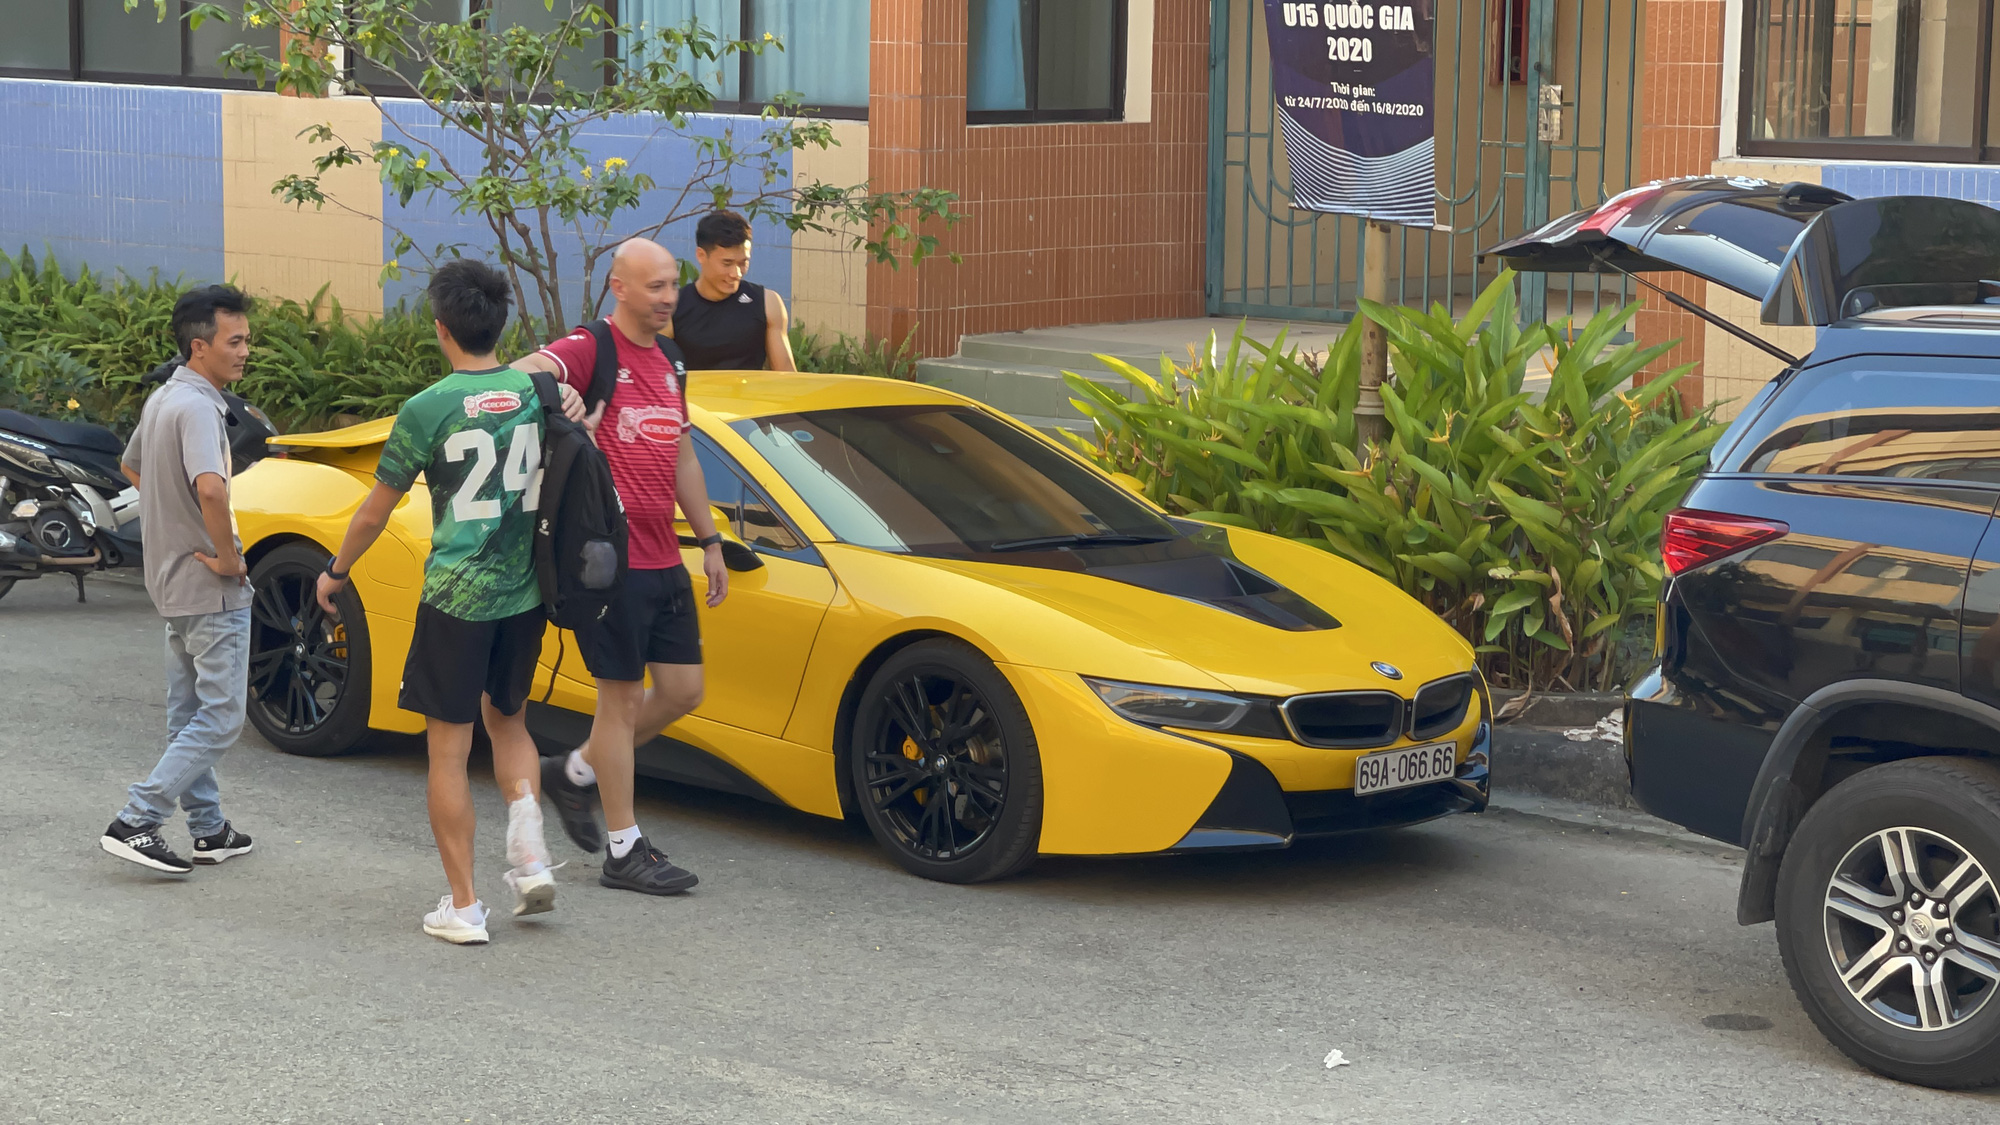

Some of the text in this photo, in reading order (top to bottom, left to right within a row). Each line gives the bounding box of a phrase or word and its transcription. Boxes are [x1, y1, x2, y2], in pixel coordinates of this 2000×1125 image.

[1283, 3, 1319, 27] U15
[1379, 5, 1414, 31] GIA
[1327, 36, 1373, 62] 2020
[1330, 81, 1376, 98] Thời gian:
[1284, 95, 1424, 116] từ 24/7/2020 đến 16/8/2020
[444, 422, 545, 522] 24
[1359, 746, 1453, 790] 69A-066.66
